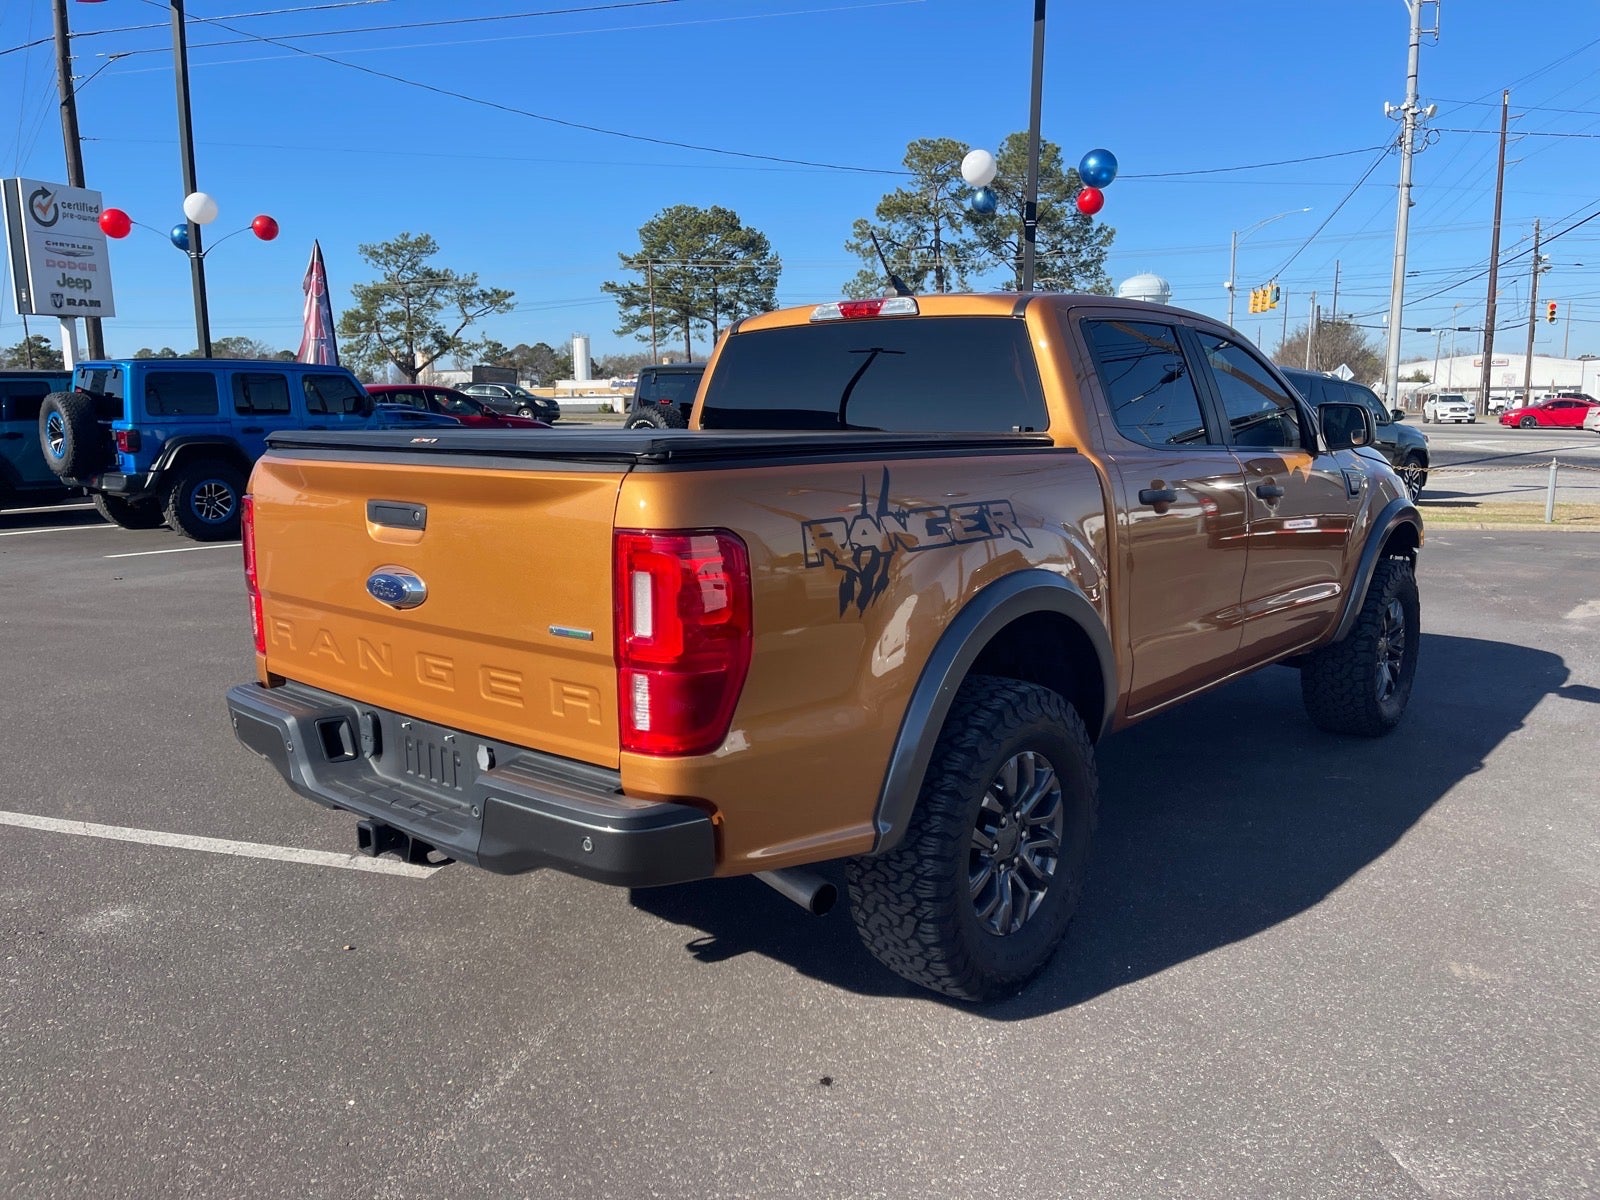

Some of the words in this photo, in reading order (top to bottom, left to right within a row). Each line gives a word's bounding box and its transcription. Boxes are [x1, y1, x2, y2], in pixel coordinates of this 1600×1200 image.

[61, 201, 99, 213] certified
[45, 240, 93, 250] CHRYSLER
[45, 259, 97, 271] DODGE
[57, 273, 92, 292] Jeep
[66, 298, 101, 308] RAM
[801, 499, 1033, 570] RANGER
[269, 615, 600, 725] RANGER
